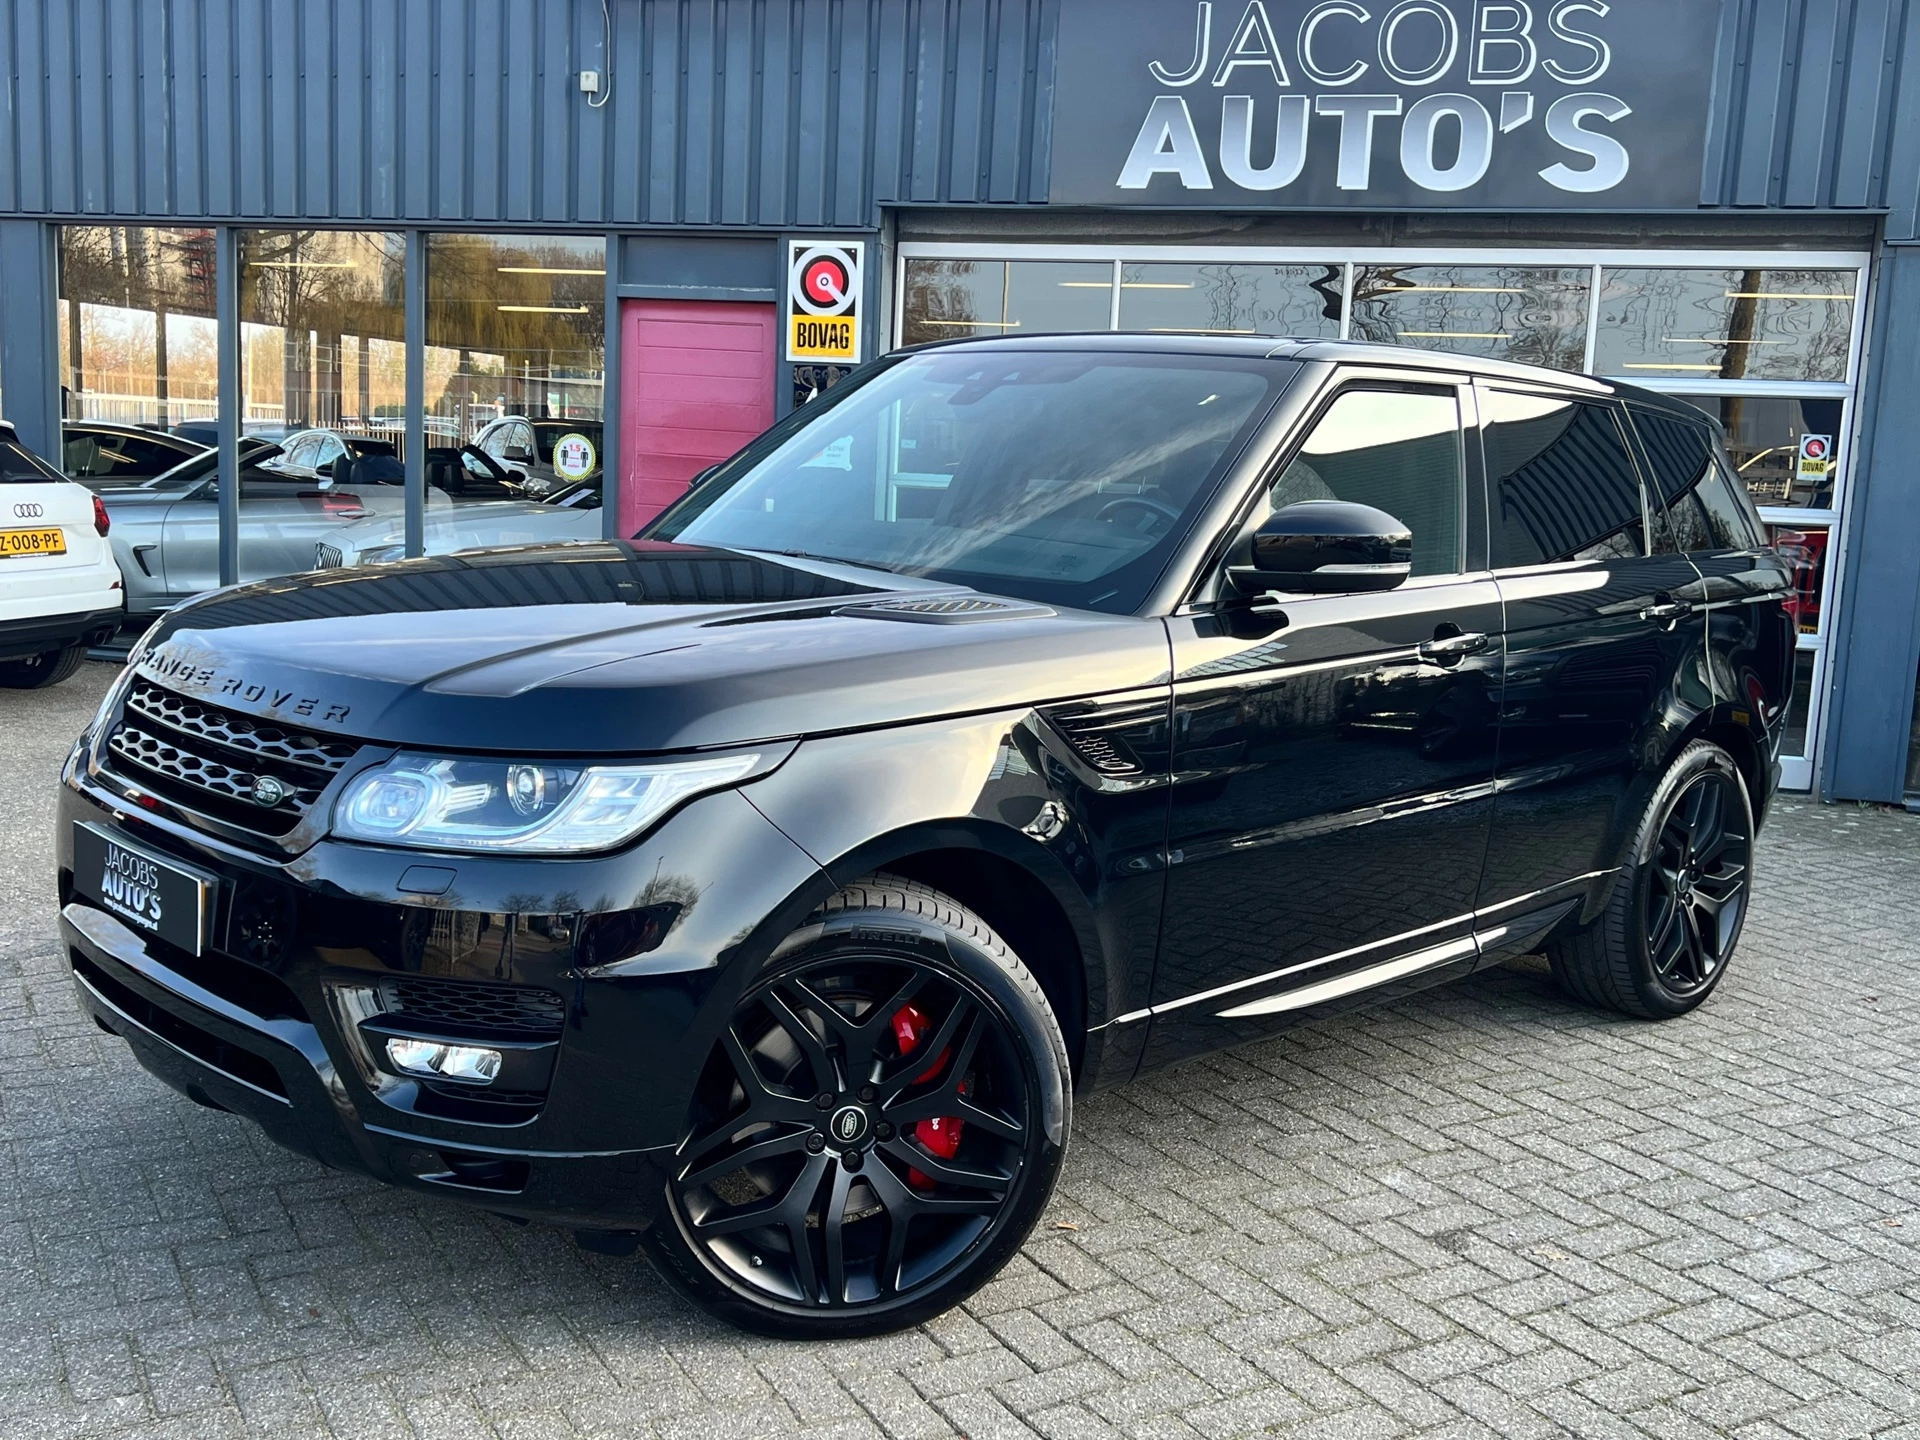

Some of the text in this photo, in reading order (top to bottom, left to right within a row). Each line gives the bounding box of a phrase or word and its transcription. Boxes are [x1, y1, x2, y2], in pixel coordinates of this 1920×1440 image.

[1148, 0, 1611, 86] JACOBS
[1116, 92, 1632, 192] AUTO'S
[797, 322, 849, 349] BOVAG
[569, 443, 581, 453] 1.5
[1802, 461, 1824, 472] BOVAG
[139, 648, 350, 723] RANGE ROVER
[104, 843, 159, 889] JACOBS
[101, 867, 162, 920] AUTO'S
[849, 923, 922, 945] PIRELLI
